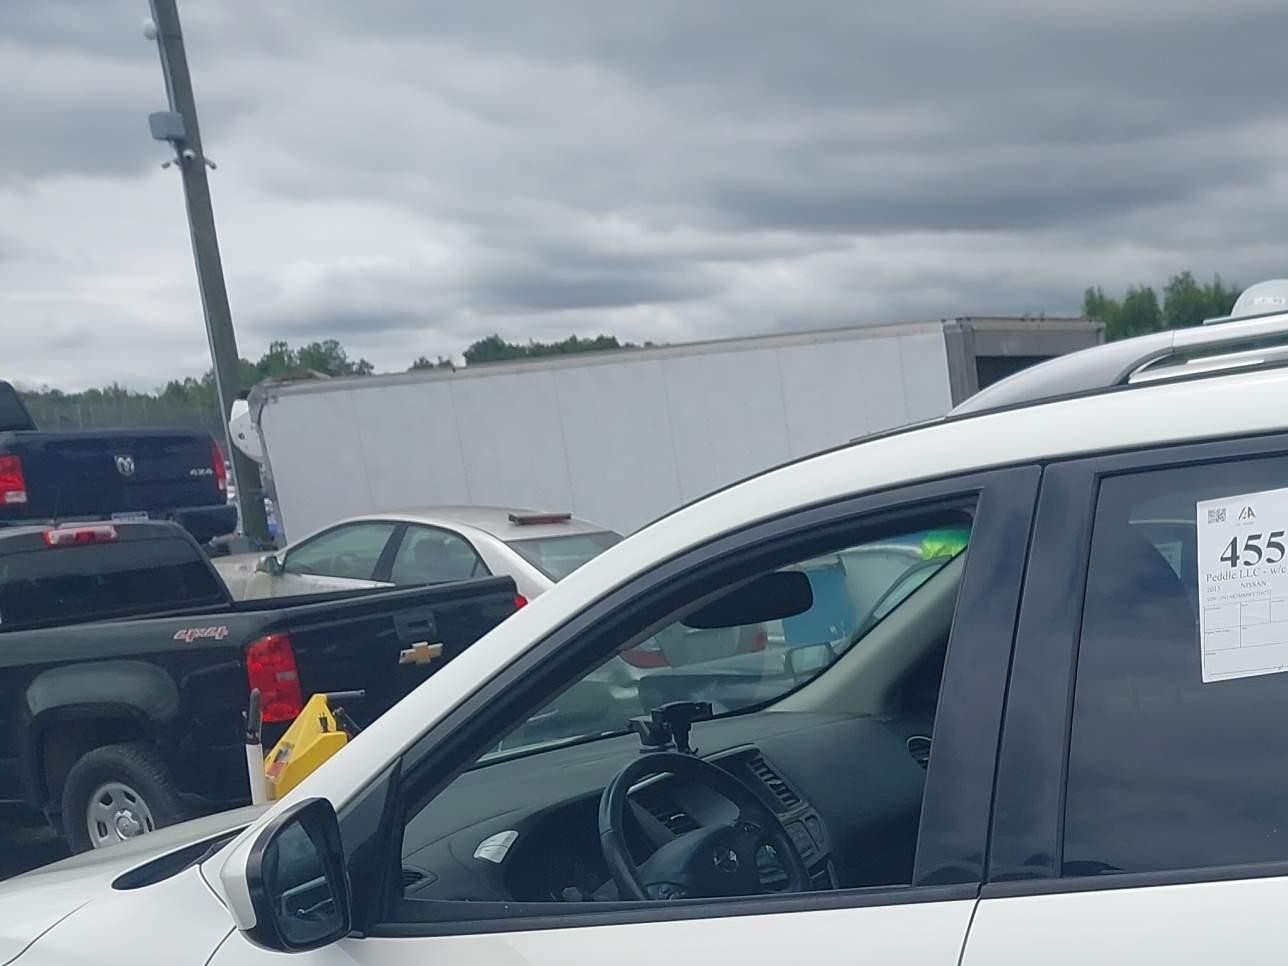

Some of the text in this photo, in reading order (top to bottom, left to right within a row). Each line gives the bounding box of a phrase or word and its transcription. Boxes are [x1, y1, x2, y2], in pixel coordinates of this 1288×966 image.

[1206, 570, 1237, 583] Peddle
[1239, 567, 1260, 579] LLC
[1240, 580, 1267, 588] NISSAN
